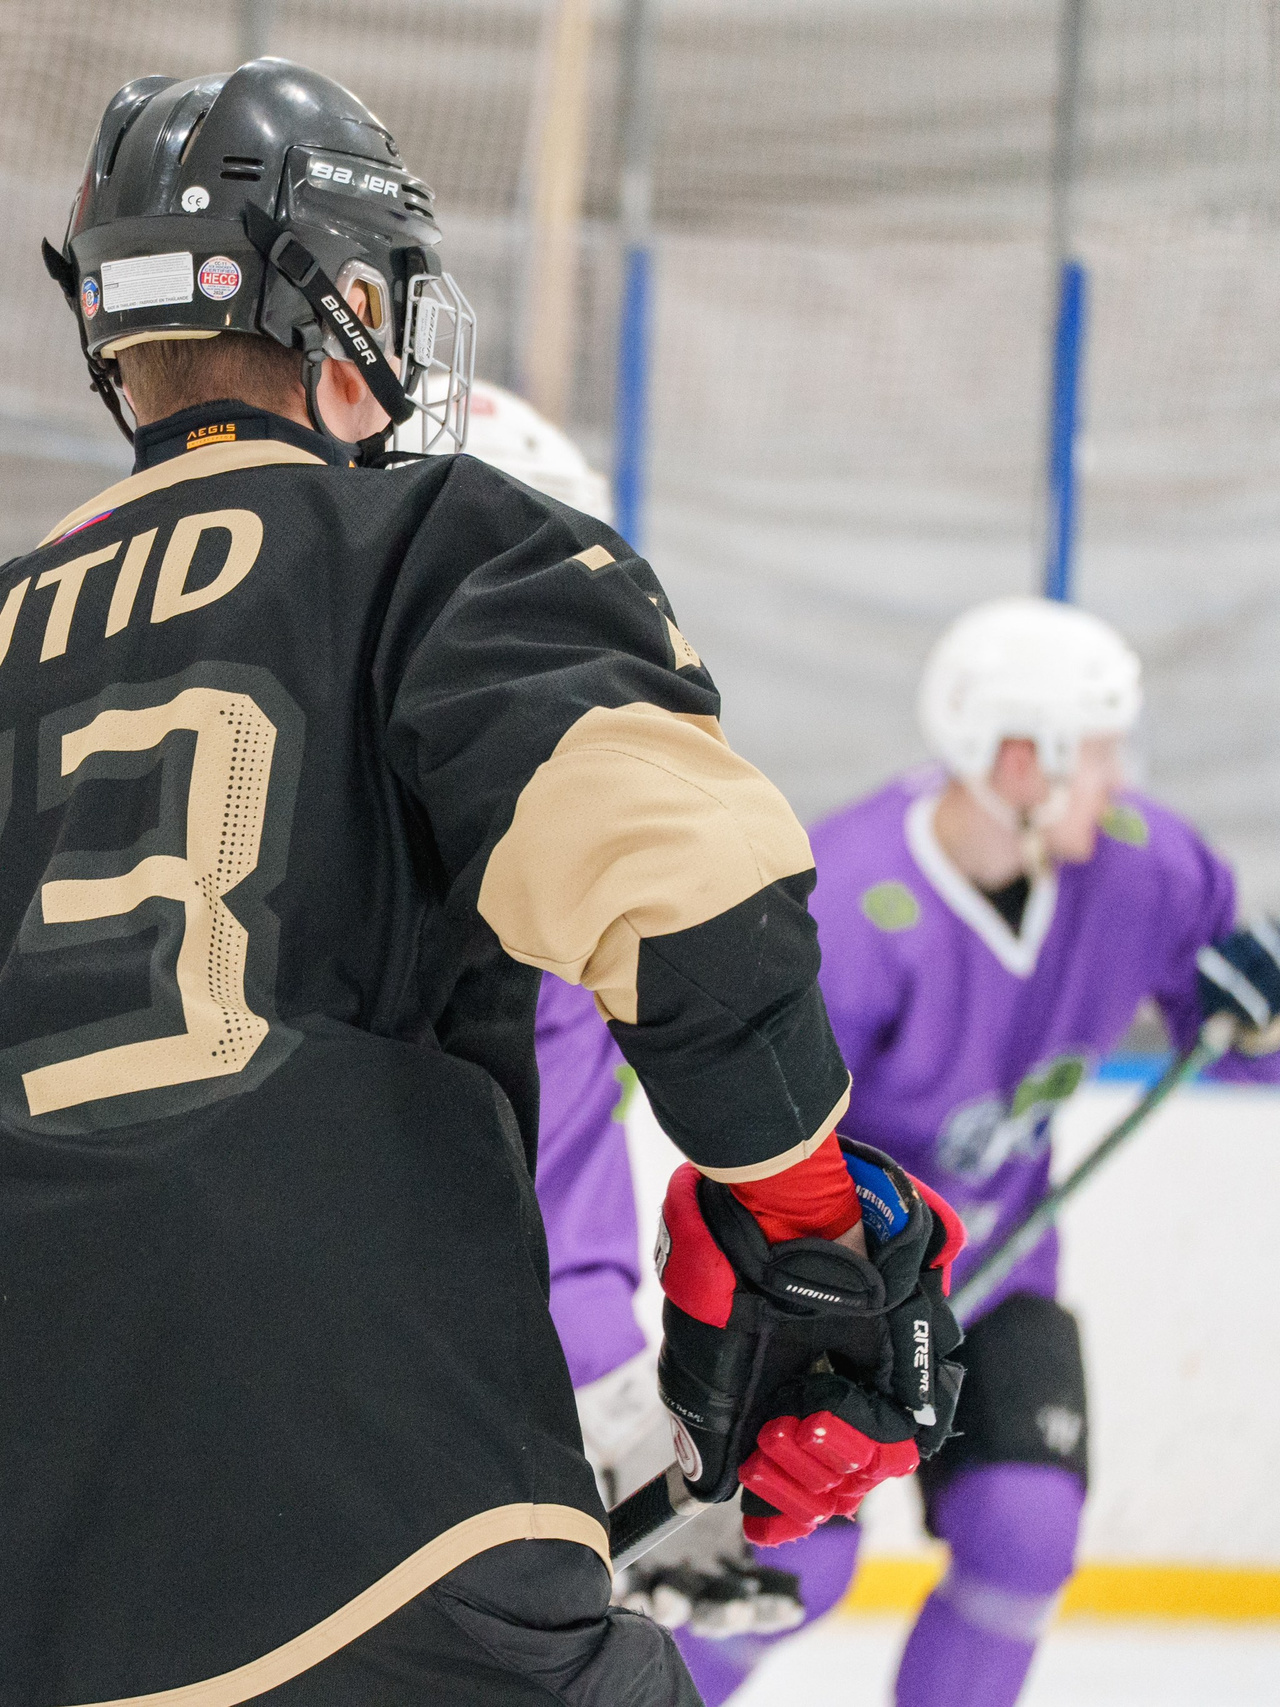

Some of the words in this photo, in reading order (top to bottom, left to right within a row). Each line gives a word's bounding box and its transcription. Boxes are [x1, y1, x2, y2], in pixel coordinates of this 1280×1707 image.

[204, 273, 236, 285] HECC
[321, 295, 377, 365] BAUER
[187, 424, 236, 440] AEGIS
[913, 1320, 929, 1369] QRE
